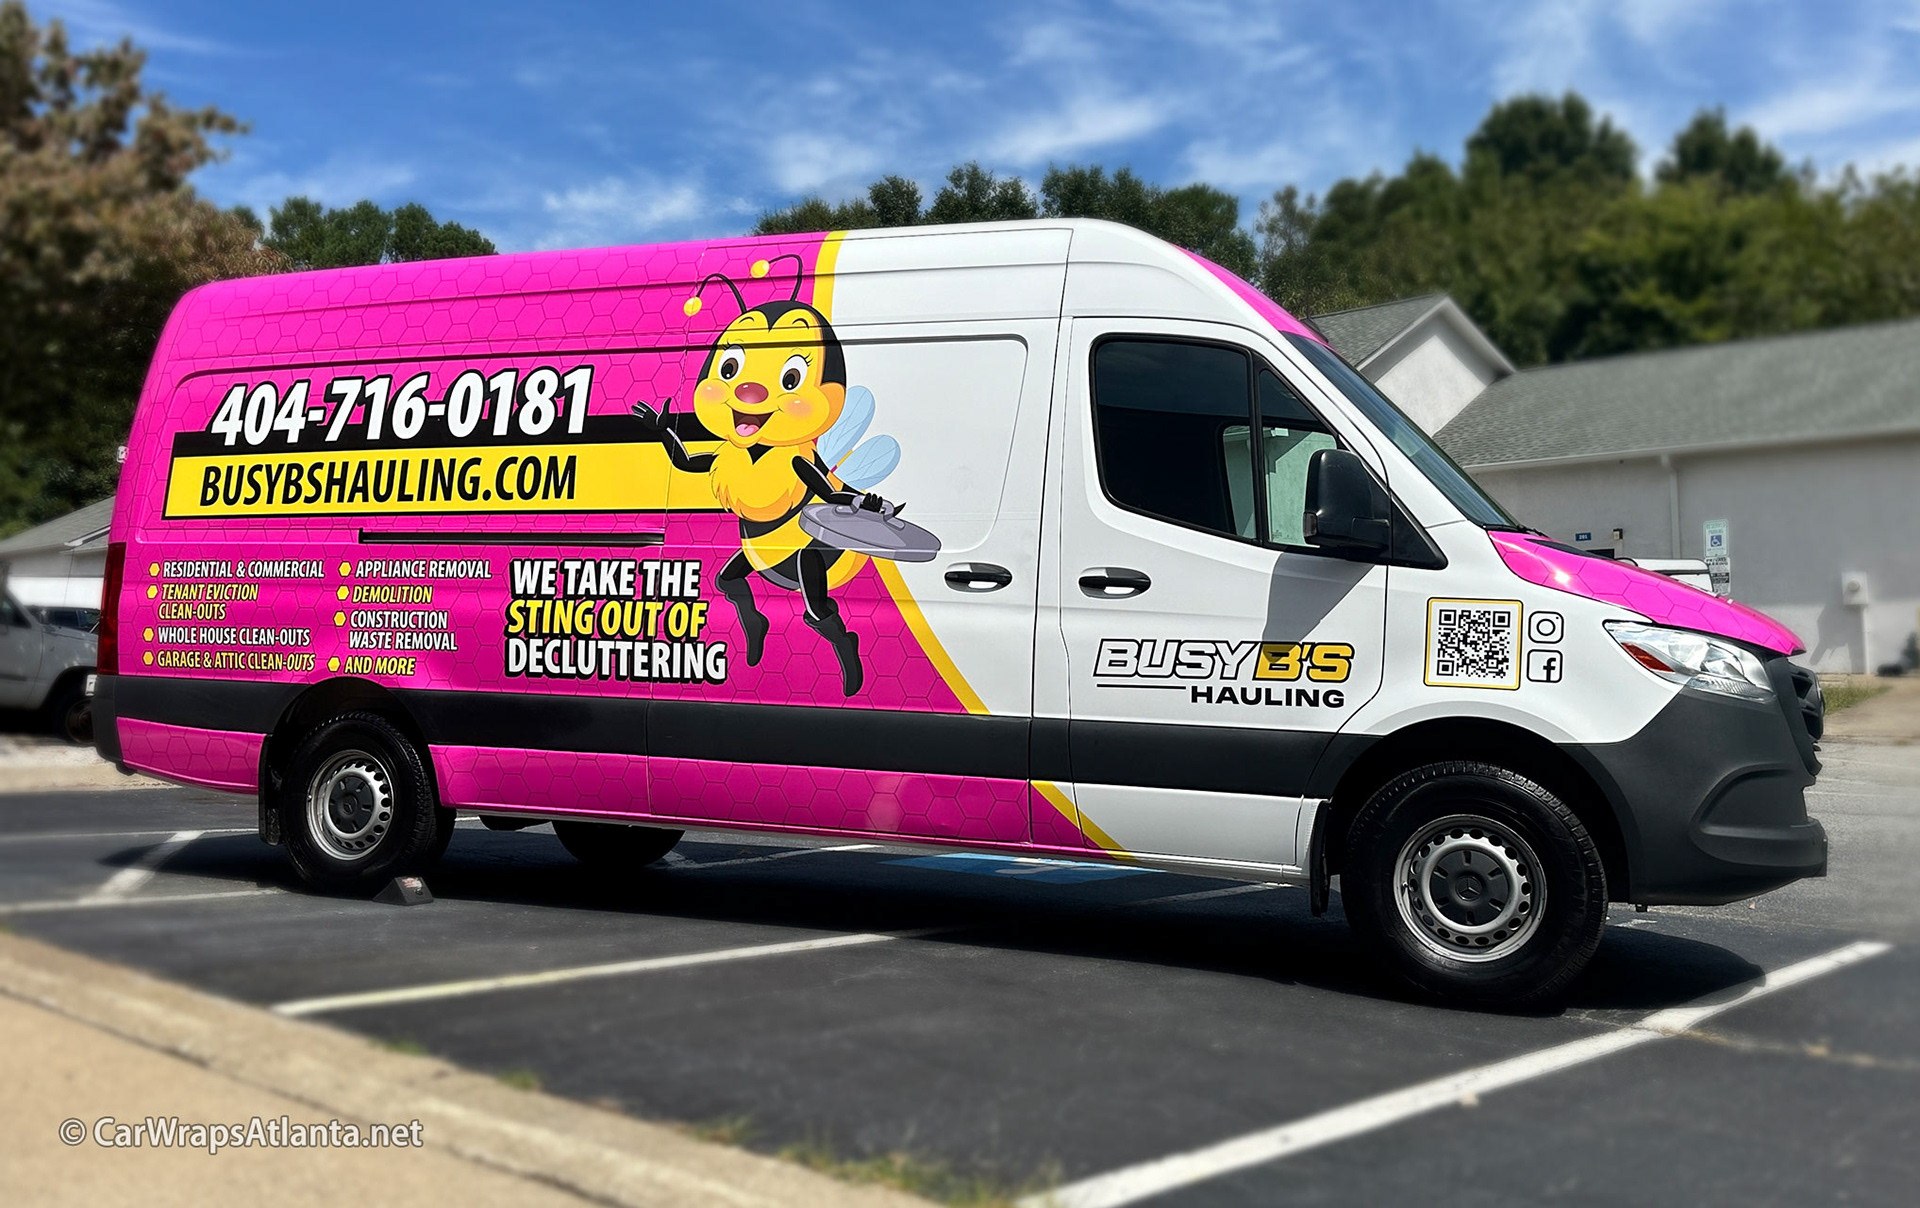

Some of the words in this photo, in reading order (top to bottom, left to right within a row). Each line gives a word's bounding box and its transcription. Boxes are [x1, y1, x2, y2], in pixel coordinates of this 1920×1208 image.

[211, 367, 594, 447] 404-716-0181
[200, 455, 577, 507] BUSYBSHAULING.COM
[162, 562, 233, 579] RESIDENTIAL
[236, 562, 246, 578] &
[247, 561, 325, 579] COMMERCIAL
[355, 561, 427, 578] APPLIANCE
[428, 561, 492, 579] REMOVAL
[513, 560, 557, 596] WE
[563, 560, 635, 597] TAKE
[642, 560, 701, 598] THE
[161, 584, 204, 600] TENANT
[205, 584, 259, 601] EVICTION
[352, 586, 433, 604] DEMOLITION
[158, 603, 226, 621] CLEAN-OUTS
[350, 610, 448, 630] CONSTRUCTION
[508, 599, 596, 636] STING
[600, 600, 662, 637] OUT
[667, 602, 708, 638] OF
[157, 627, 197, 645] WHOLE
[199, 628, 237, 645] HOUSE
[238, 628, 310, 647] CLEAN-OUTS
[349, 631, 393, 650] WASTE
[393, 632, 458, 651] REMOVAL
[157, 651, 202, 668] GARAGE
[203, 652, 212, 668] &
[214, 652, 246, 669] ATTIC
[247, 653, 315, 671] CLEAN-OUTS
[344, 655, 370, 675] AND
[371, 657, 416, 676] MORE
[508, 637, 727, 680] DECLUTTERING
[1190, 685, 1345, 709] HAULING
